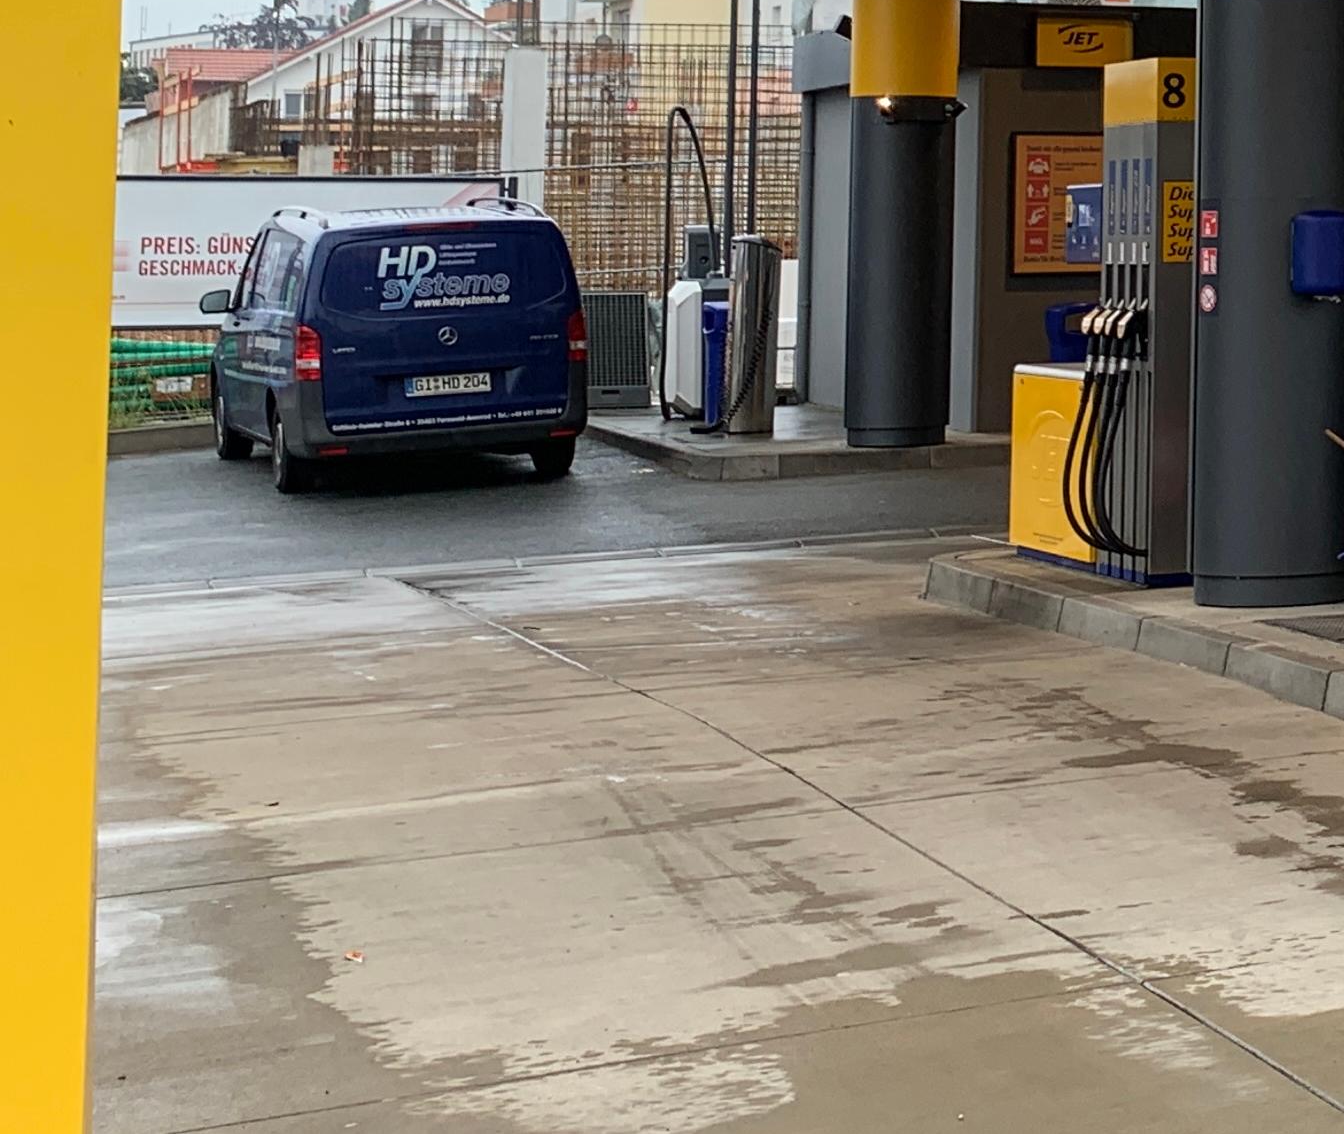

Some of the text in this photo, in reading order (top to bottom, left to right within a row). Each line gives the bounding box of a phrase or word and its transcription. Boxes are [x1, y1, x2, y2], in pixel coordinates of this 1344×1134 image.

[1063, 32, 1099, 45] JET
[1162, 72, 1186, 109] 8
[1169, 185, 1195, 201] Die
[1168, 204, 1194, 223] Sup
[1167, 223, 1194, 242] Sup
[141, 233, 255, 255] PREIS: GÜNS
[1167, 241, 1194, 261] Sup
[138, 259, 243, 277] GESCHMACK:
[377, 245, 437, 278] HD
[380, 272, 511, 311] systeme
[413, 294, 511, 309] www.hdsysteme.de
[414, 374, 489, 393] GI HD 204
